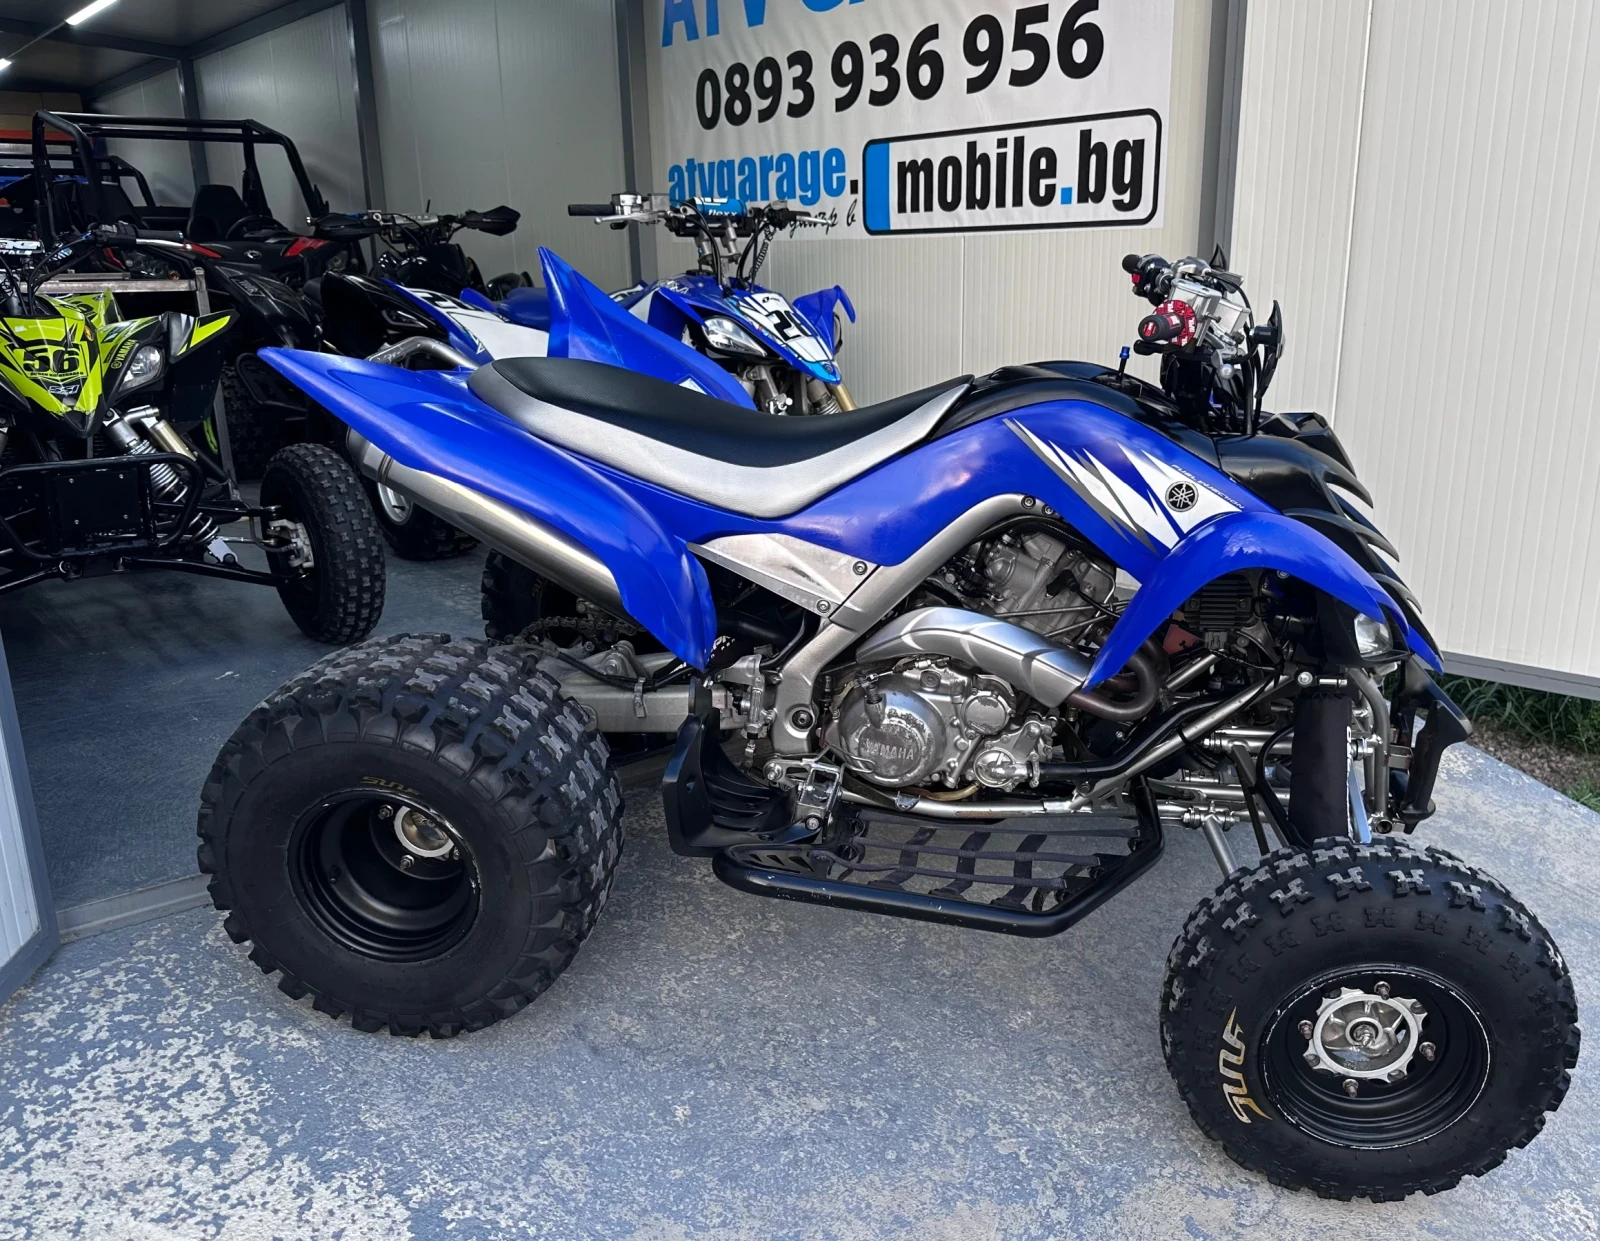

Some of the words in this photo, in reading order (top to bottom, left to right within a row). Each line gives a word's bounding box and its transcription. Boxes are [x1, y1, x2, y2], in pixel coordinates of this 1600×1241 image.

[696, 50, 815, 130] 0893
[831, 23, 944, 113] 936
[963, 0, 1104, 94] 956
[897, 129, 1146, 212] mobile.bg
[22, 344, 80, 373] 56
[114, 339, 138, 361] YAMAHA
[1171, 464, 1196, 481] FUEL
[1197, 480, 1245, 509] INJECTION
[862, 738, 915, 760] YAMAHA
